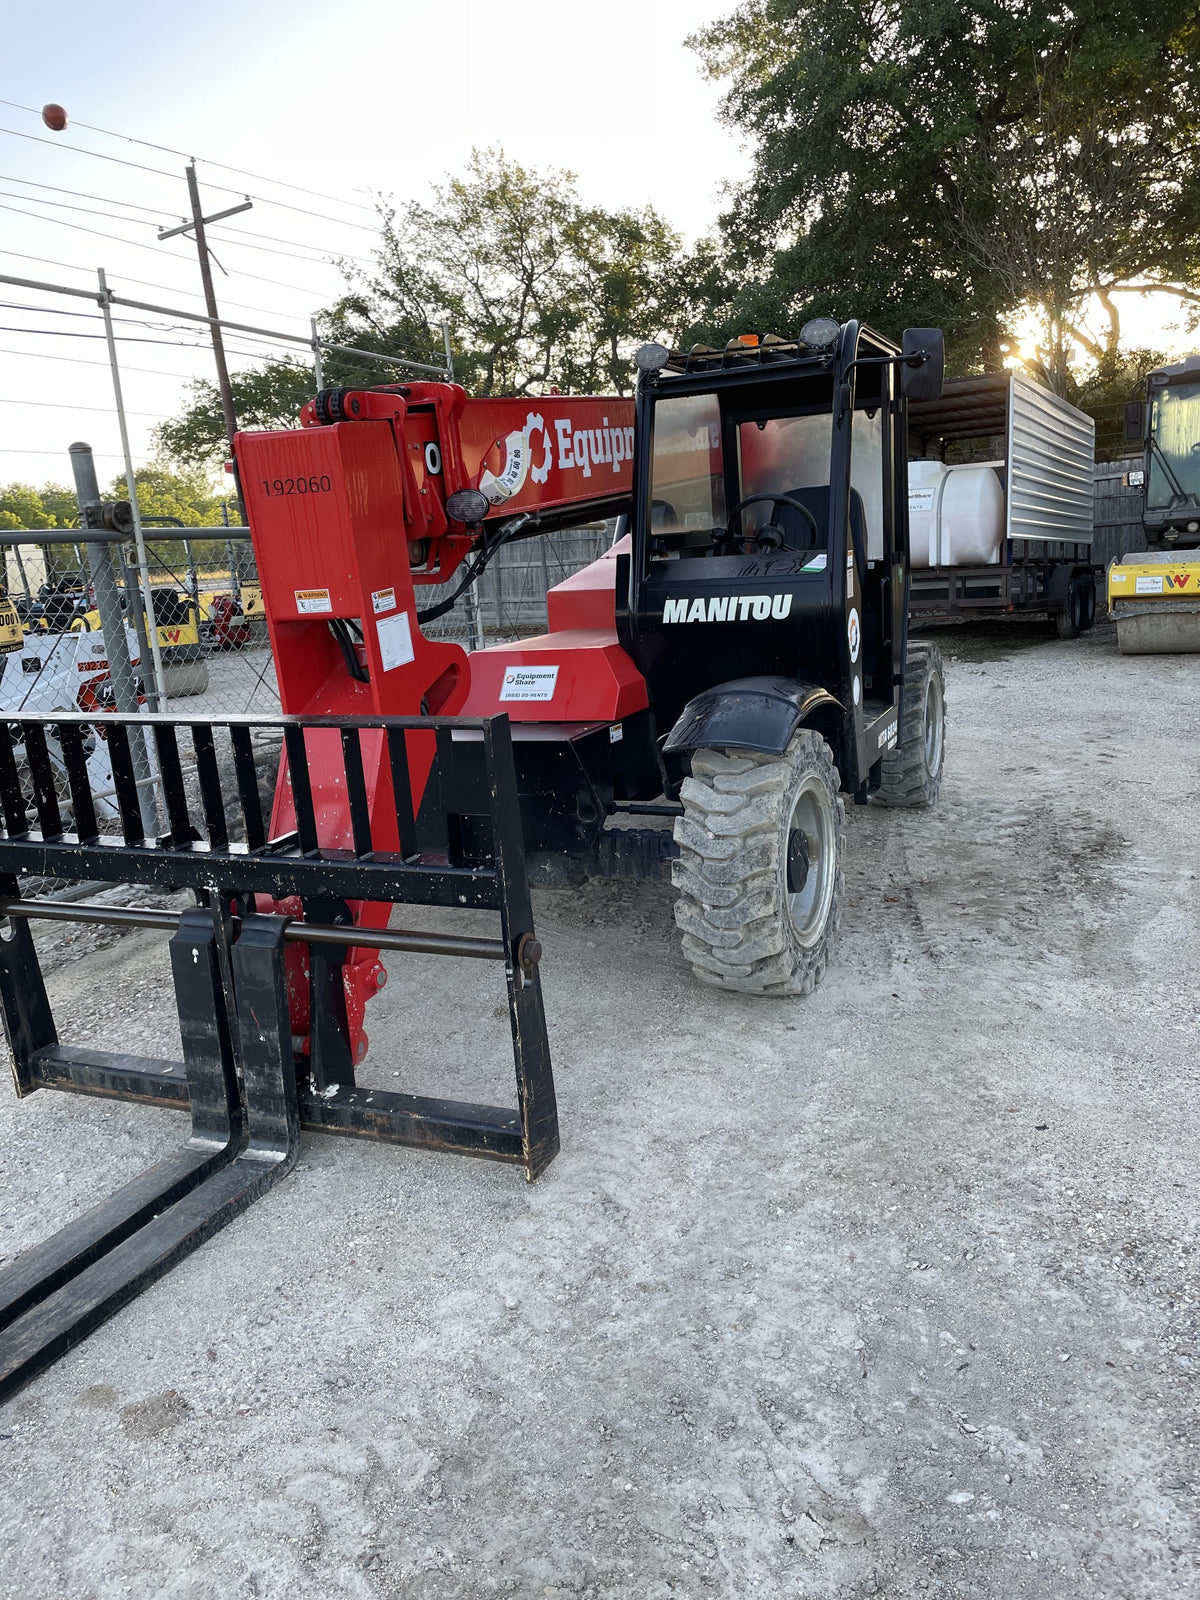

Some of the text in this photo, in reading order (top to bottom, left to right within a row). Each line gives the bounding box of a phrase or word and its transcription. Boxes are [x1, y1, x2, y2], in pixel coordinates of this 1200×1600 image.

[425, 442, 441, 474] 0
[261, 475, 332, 497] 192060
[662, 593, 793, 624] MANITOU
[516, 672, 555, 680] Equipment
